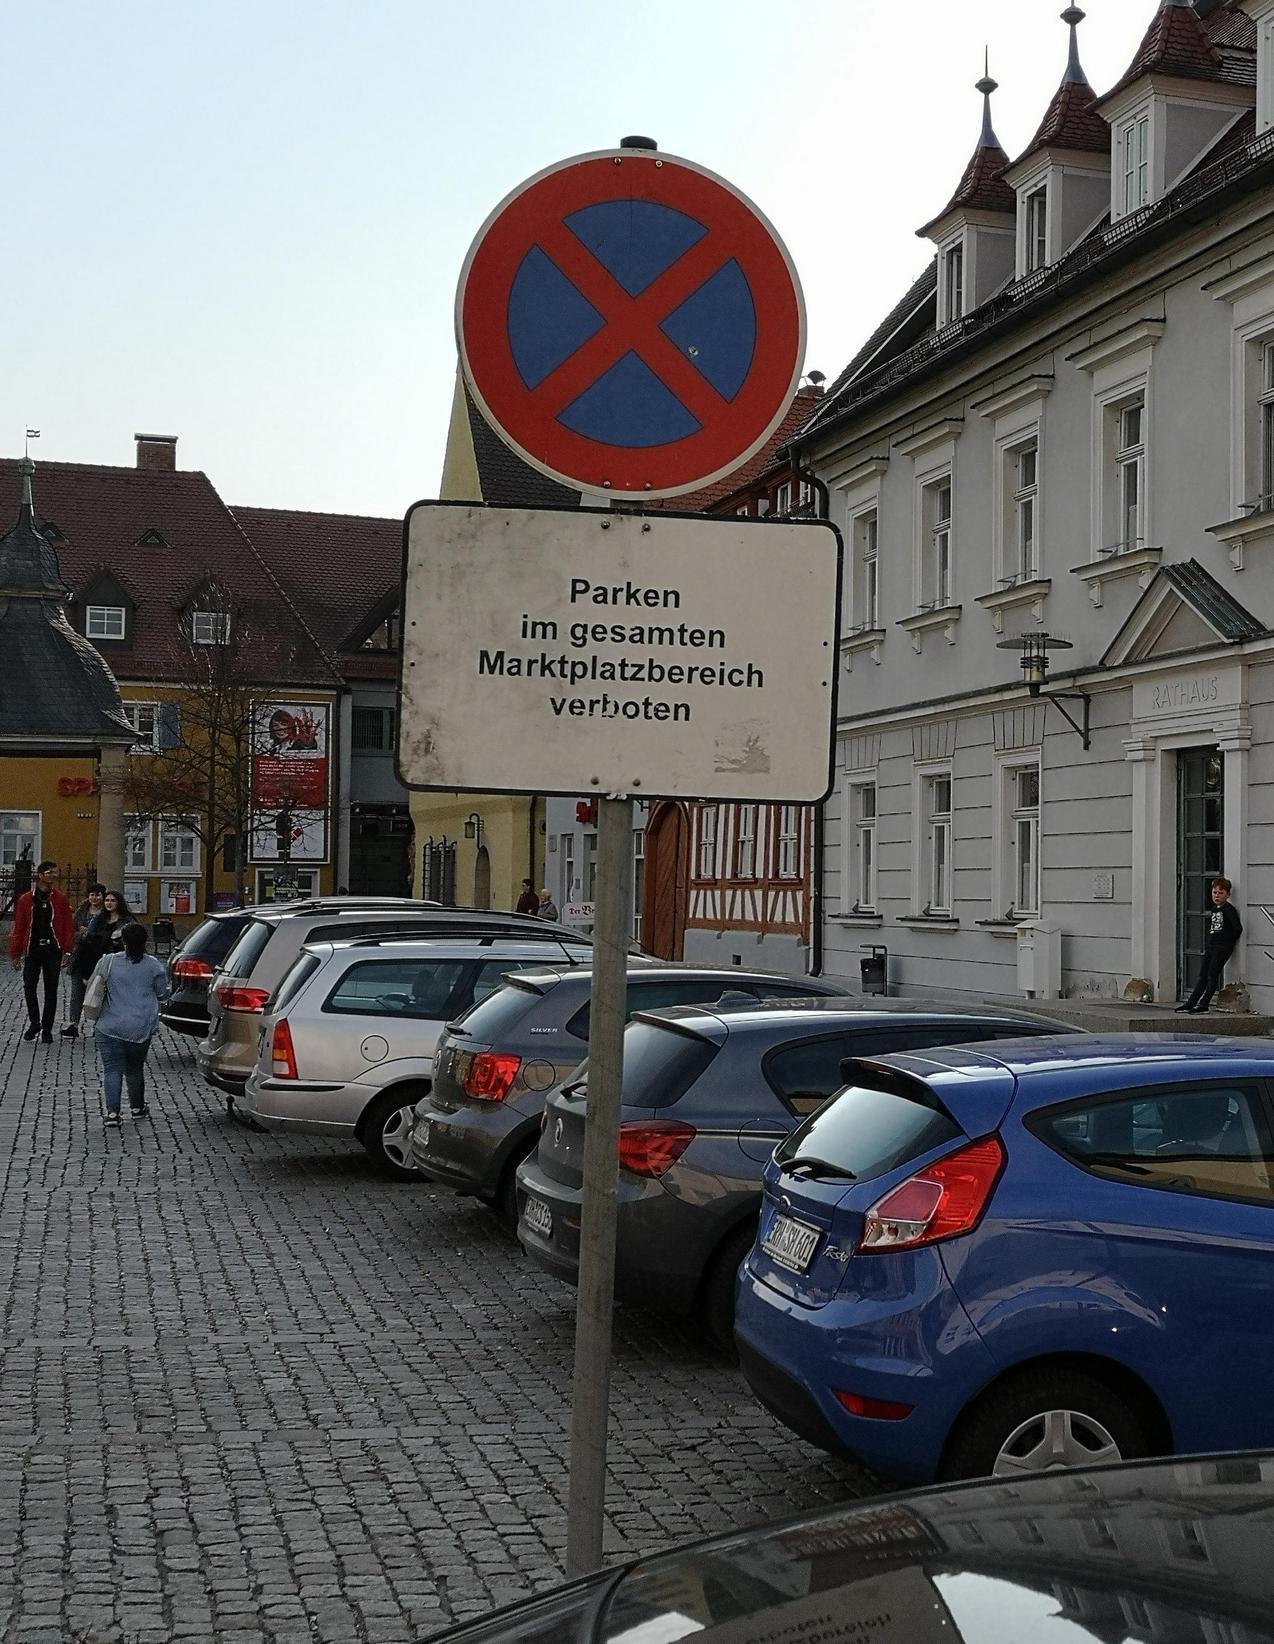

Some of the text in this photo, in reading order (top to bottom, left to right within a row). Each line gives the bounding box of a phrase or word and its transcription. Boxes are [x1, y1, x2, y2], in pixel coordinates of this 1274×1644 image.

[570, 578, 681, 609] Parken
[521, 613, 726, 648] im gesamten
[478, 649, 764, 688] Marktplatzbereich
[550, 692, 691, 722] verboten
[1152, 676, 1219, 710] RATHAUS
